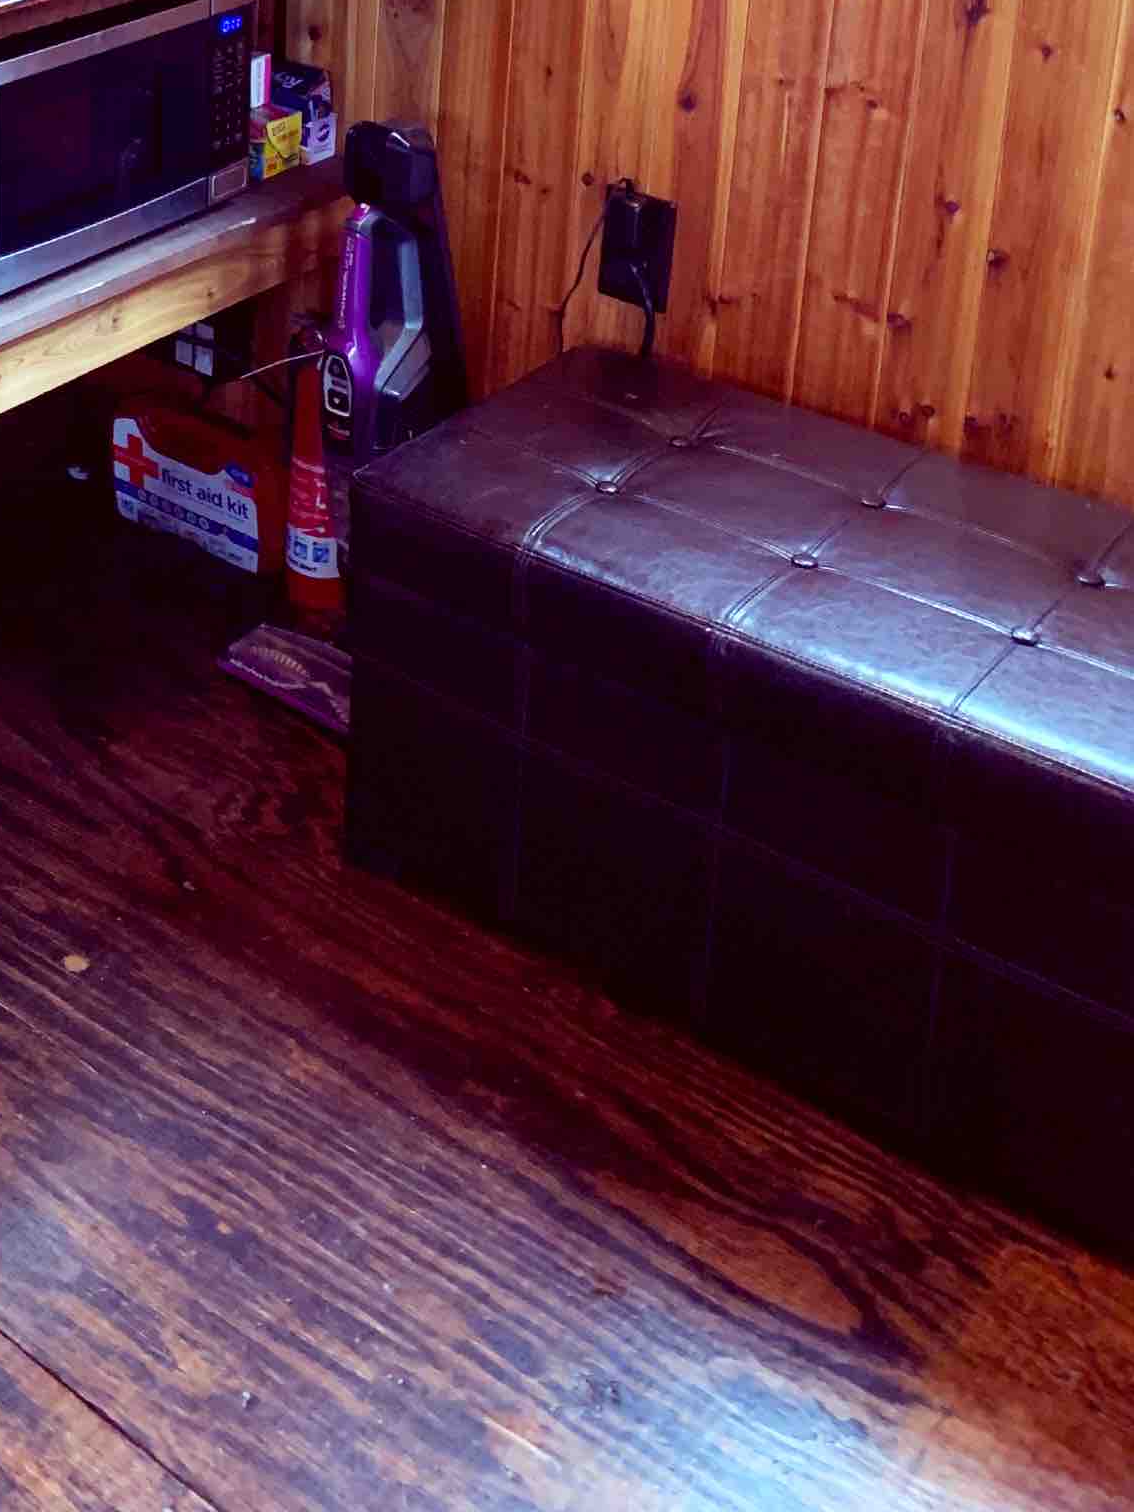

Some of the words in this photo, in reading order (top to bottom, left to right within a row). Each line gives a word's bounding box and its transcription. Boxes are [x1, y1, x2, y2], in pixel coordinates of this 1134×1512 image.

[161, 467, 194, 495] first
[197, 486, 224, 508] aid
[227, 495, 250, 520] kit
